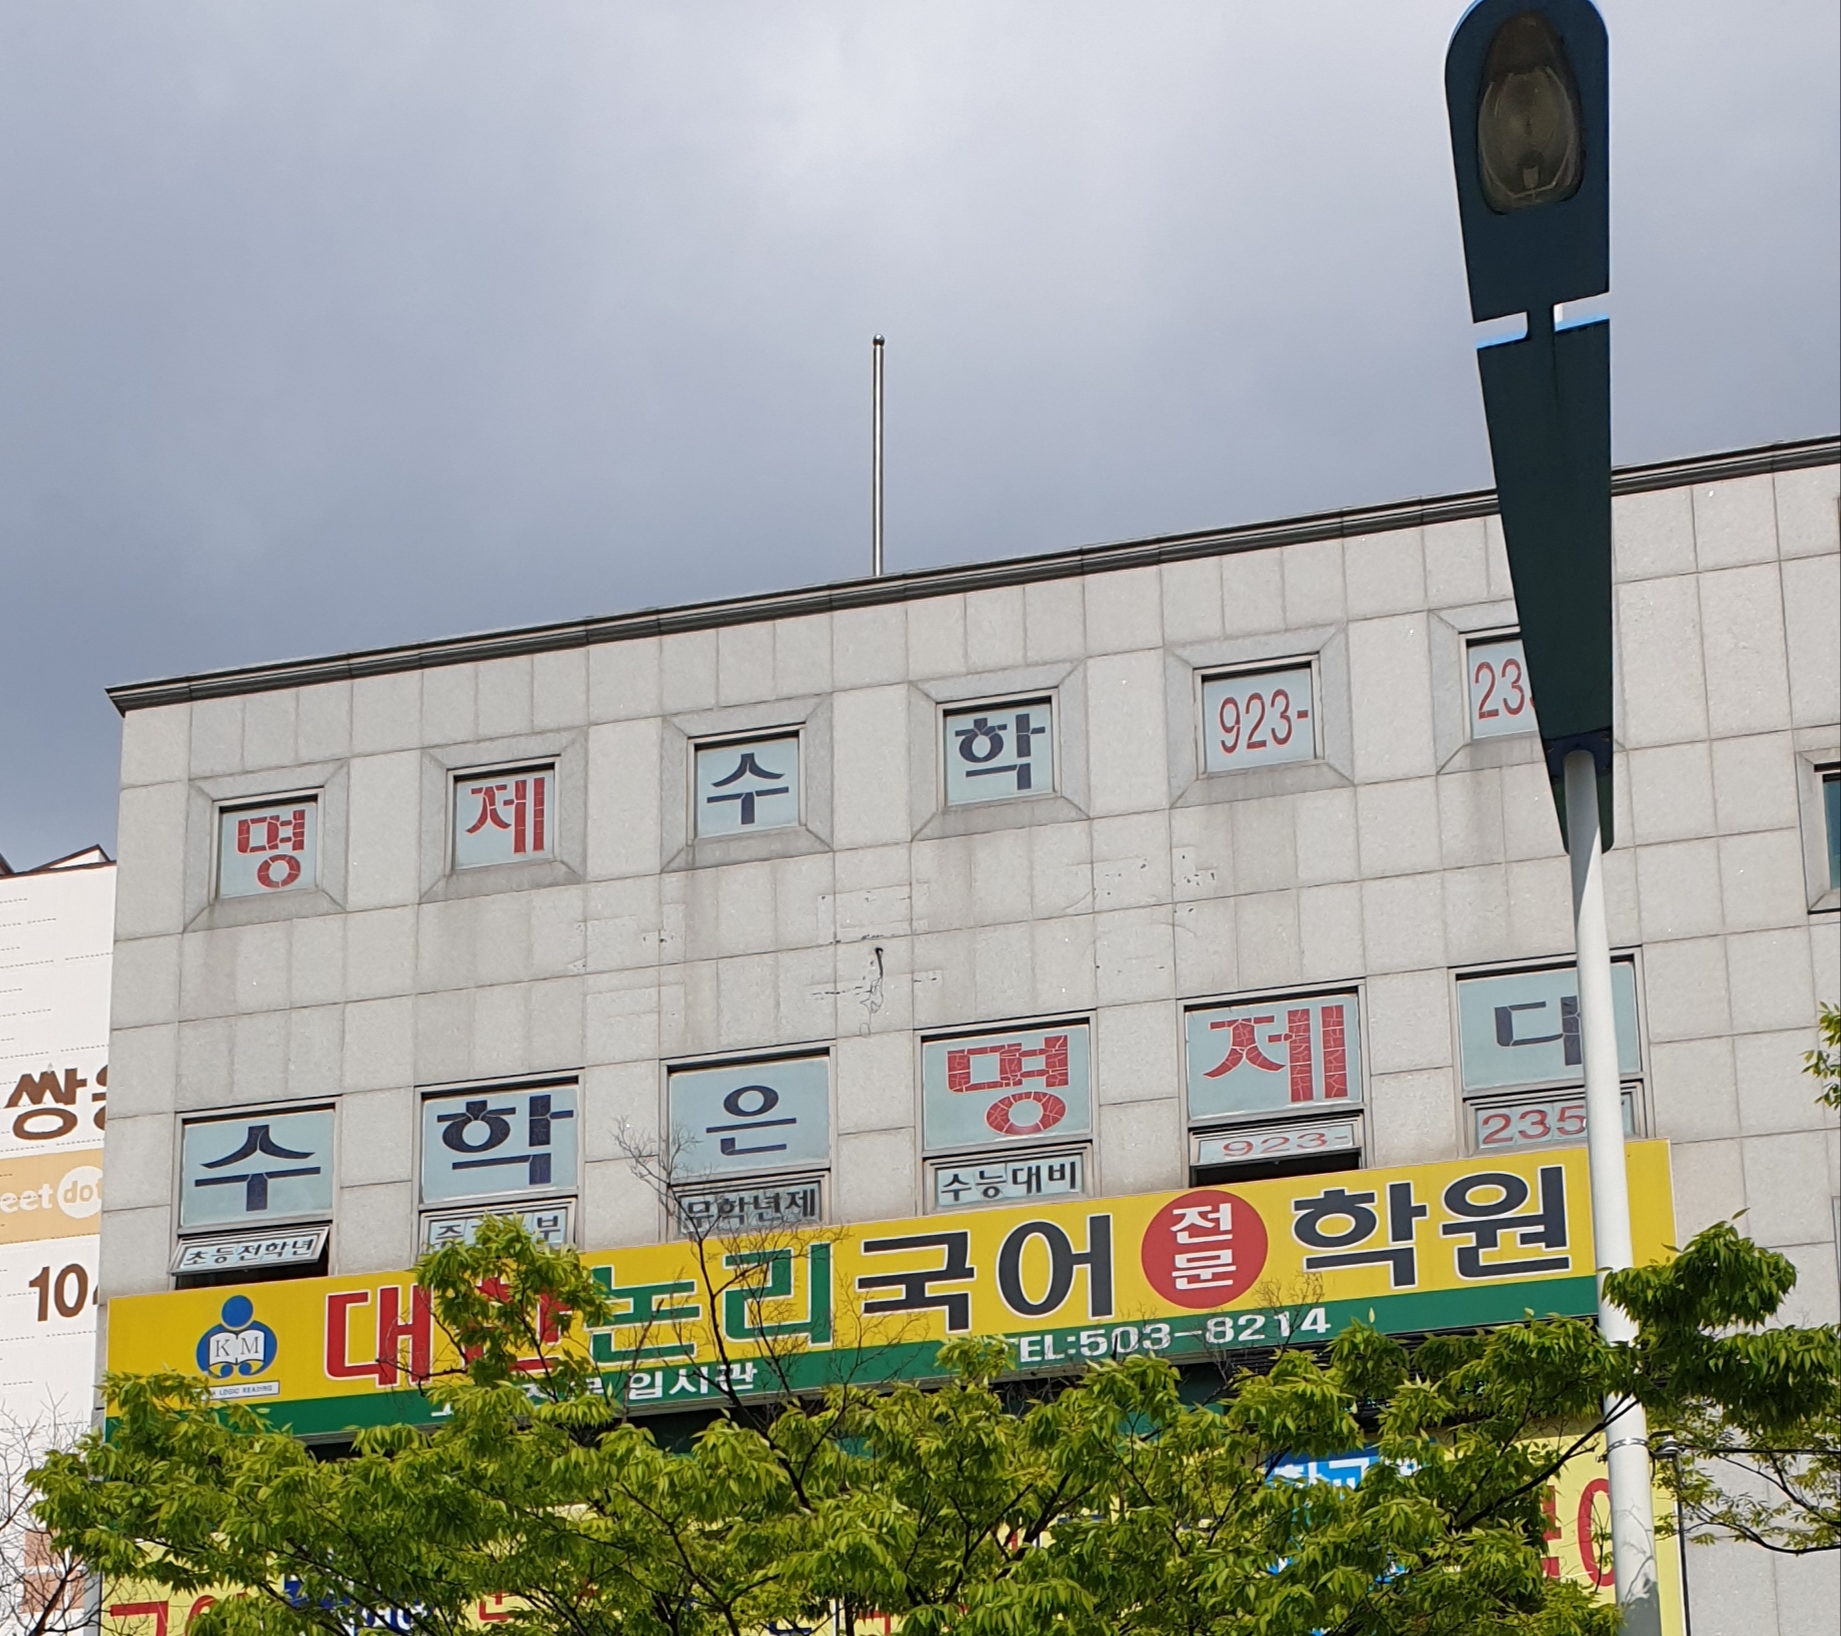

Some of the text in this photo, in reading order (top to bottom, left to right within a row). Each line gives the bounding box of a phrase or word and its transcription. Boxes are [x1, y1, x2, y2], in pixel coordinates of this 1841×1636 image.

[1474, 658, 1535, 719] 23
[1222, 1104, 1588, 1158] 923- 235
[940, 1160, 1076, 1203] 수능대비
[185, 1237, 315, 1267] 초등전학년
[1290, 1163, 1573, 1291] 학원
[28, 1263, 98, 1322] 10
